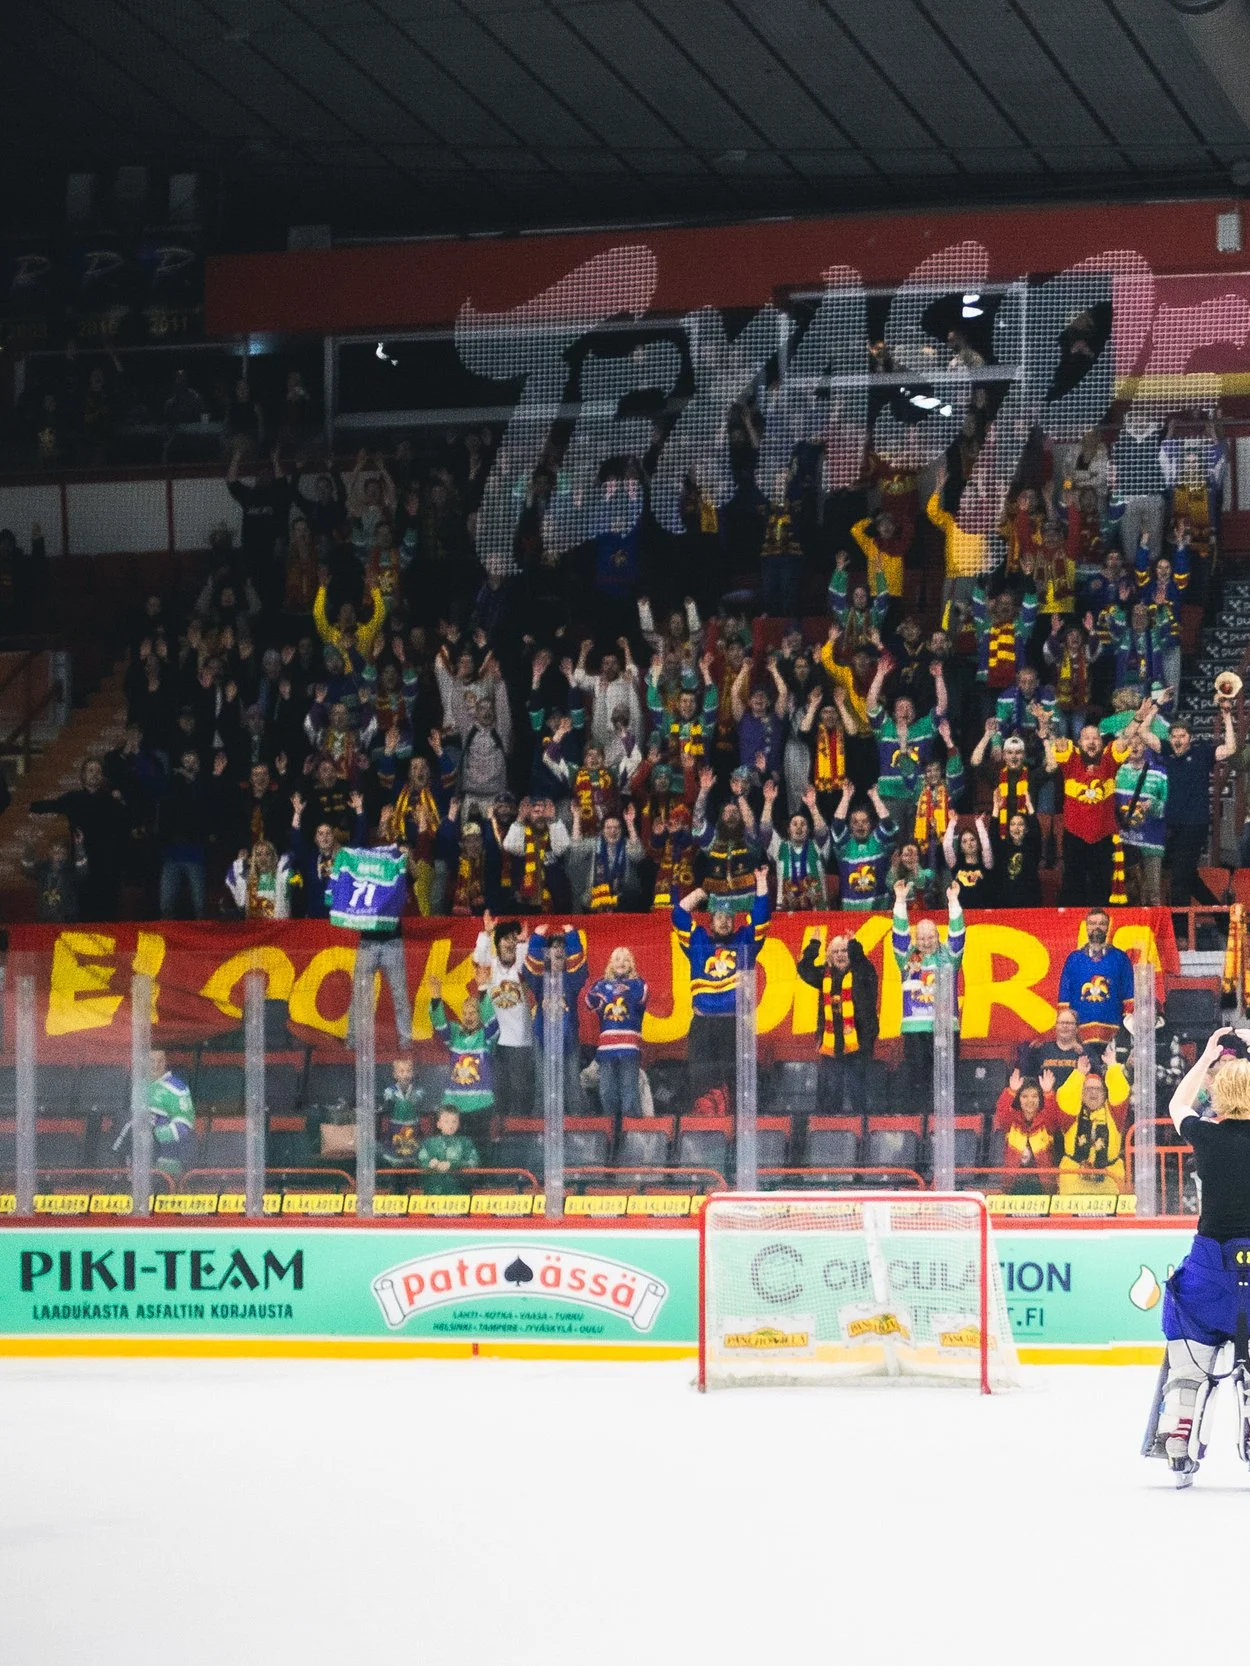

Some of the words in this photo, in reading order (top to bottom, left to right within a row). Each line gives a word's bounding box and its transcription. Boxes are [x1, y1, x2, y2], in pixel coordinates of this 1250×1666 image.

[349, 881, 377, 907] 71
[21, 1249, 304, 1291] PIKI-TEAM
[402, 1259, 498, 1306] pata
[539, 1255, 636, 1308] ässä
[33, 1304, 129, 1320] LAADUKASTA
[136, 1304, 204, 1320] ASFALTIN
[211, 1304, 293, 1319] KORJAUSTA
